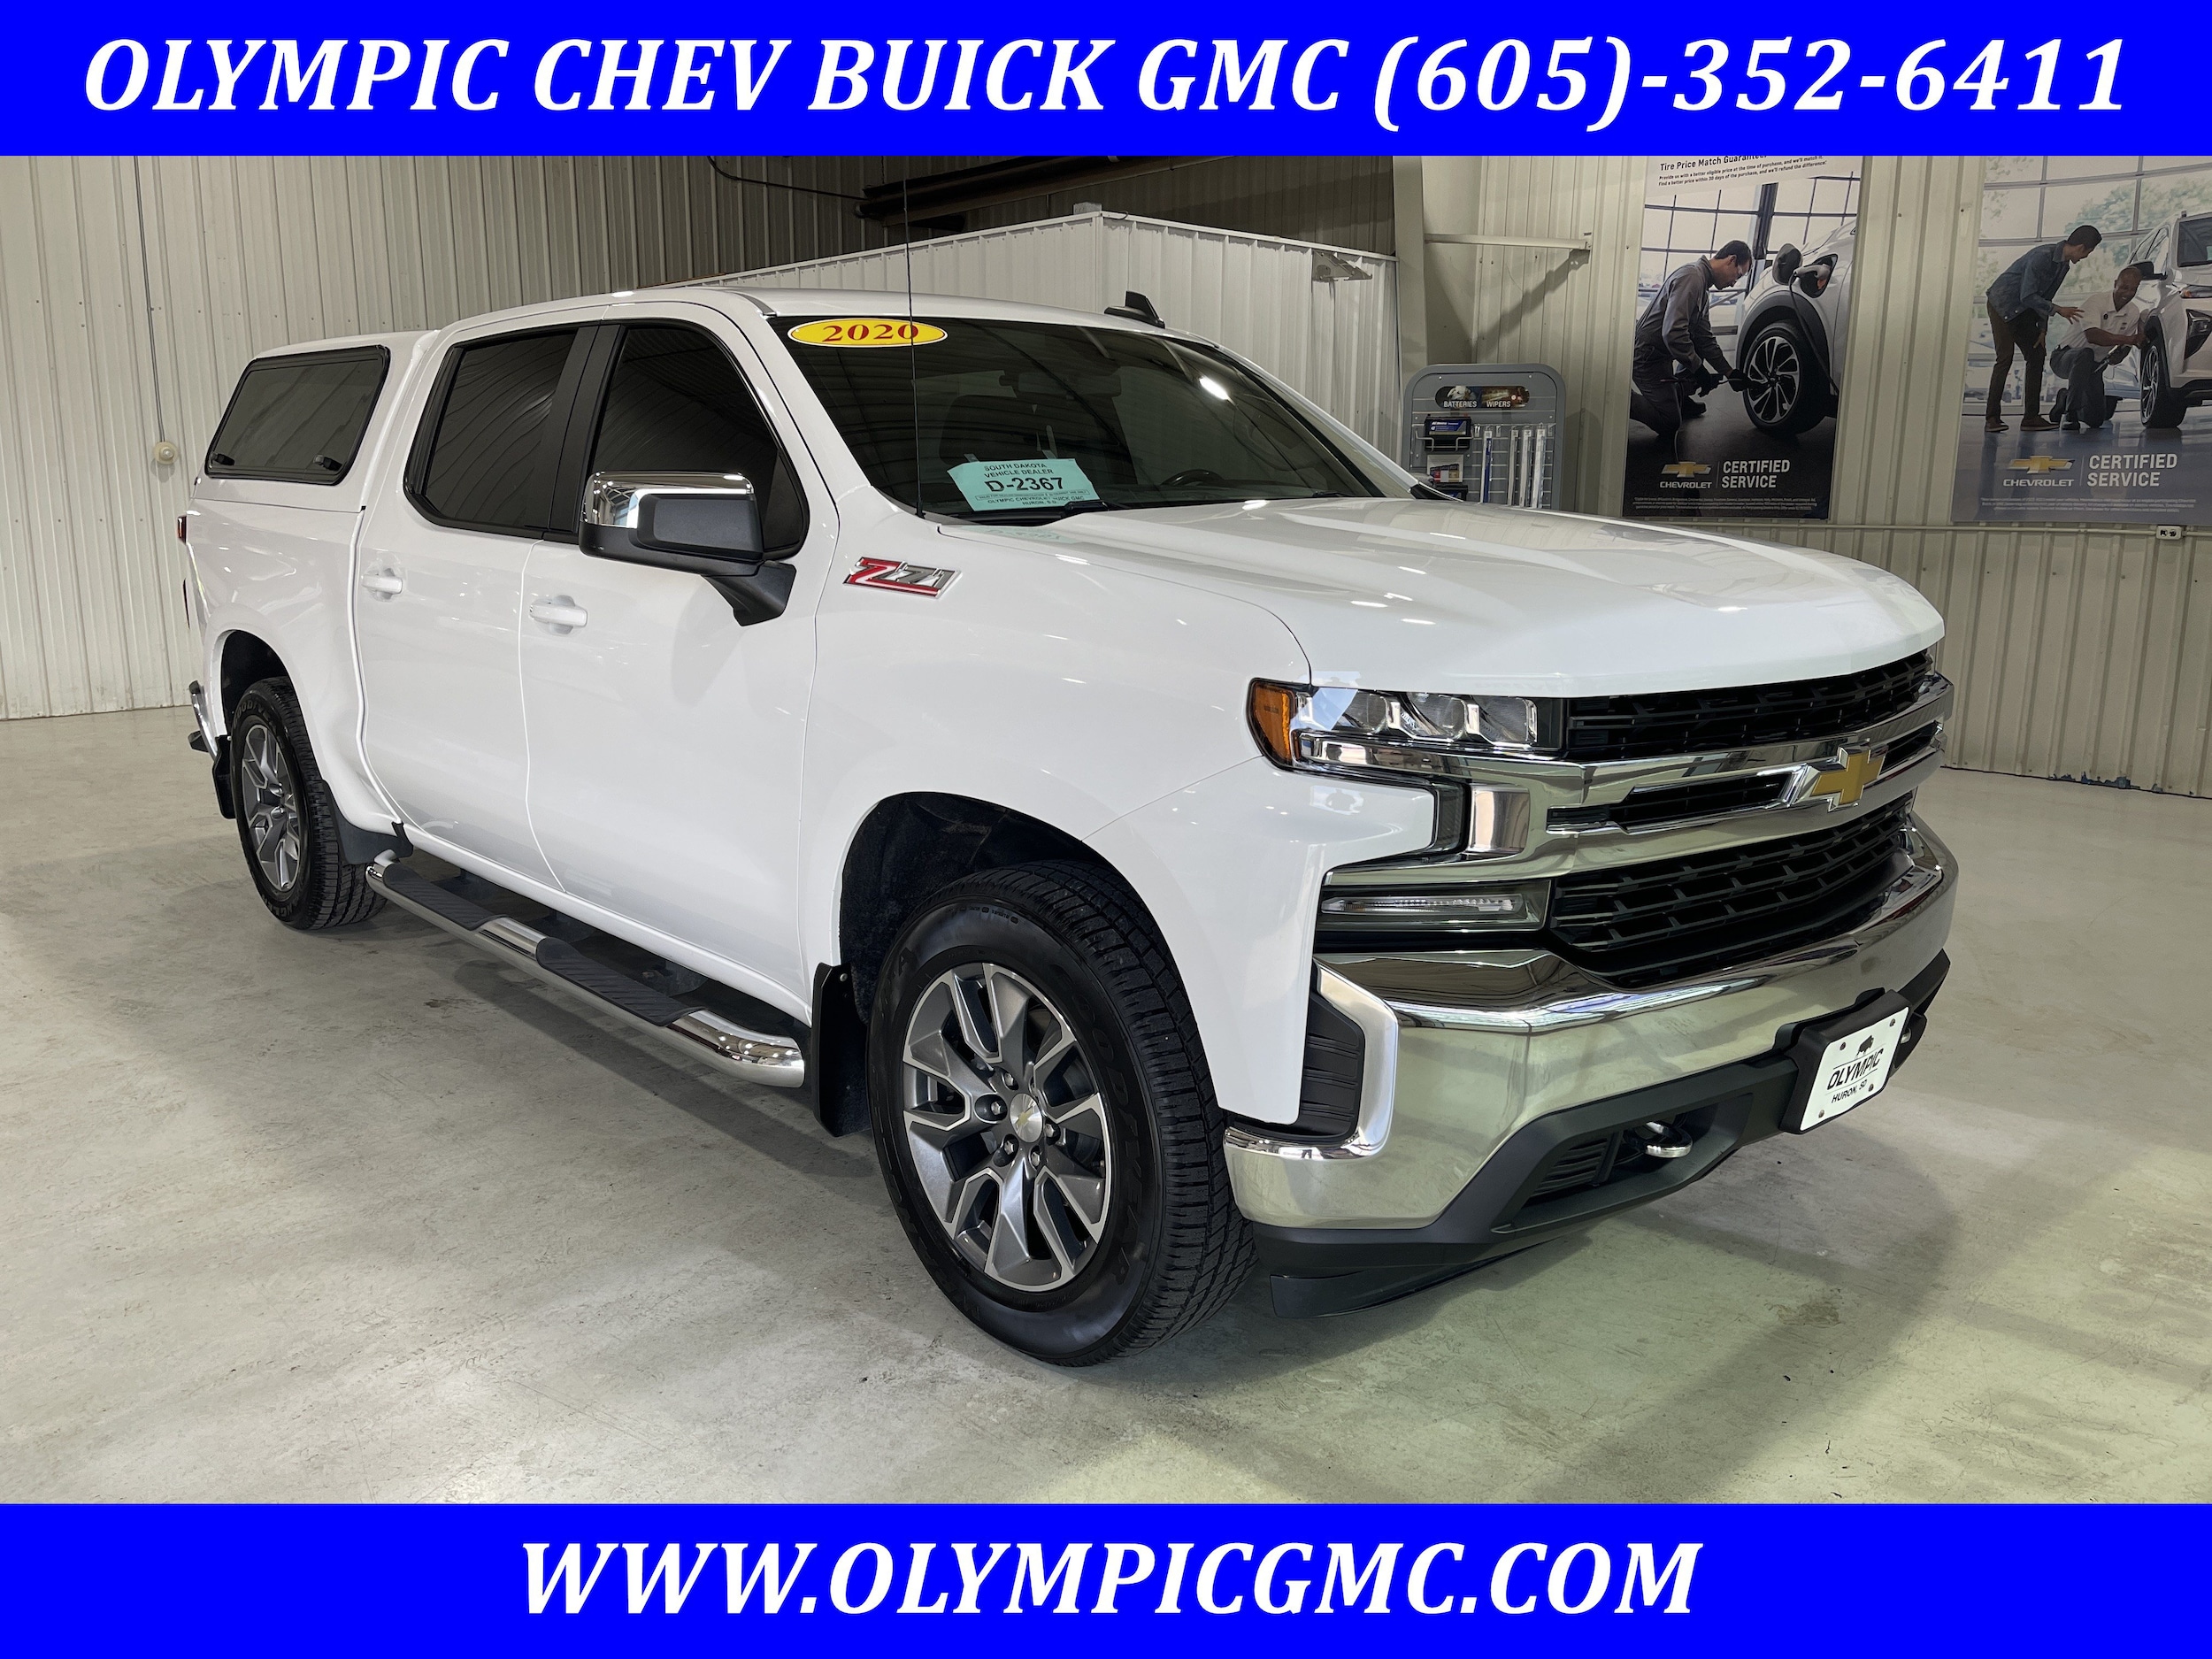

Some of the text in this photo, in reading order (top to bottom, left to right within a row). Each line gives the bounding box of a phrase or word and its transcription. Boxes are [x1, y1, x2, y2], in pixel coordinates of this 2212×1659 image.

[1699, 157, 1721, 166] Match
[822, 324, 919, 342] 2020
[1723, 459, 1790, 473] CERTIFIED
[2088, 453, 2177, 470] CERTIFIED
[984, 469, 1020, 478] VEHICLE
[1721, 475, 1777, 488] SERVICE
[2087, 472, 2161, 488] SERVICE
[984, 477, 1063, 491] D-2367
[842, 556, 963, 599] Z71
[1826, 1048, 1884, 1091] OLYMPIC
[1832, 1079, 1868, 1103] HURON, SD
